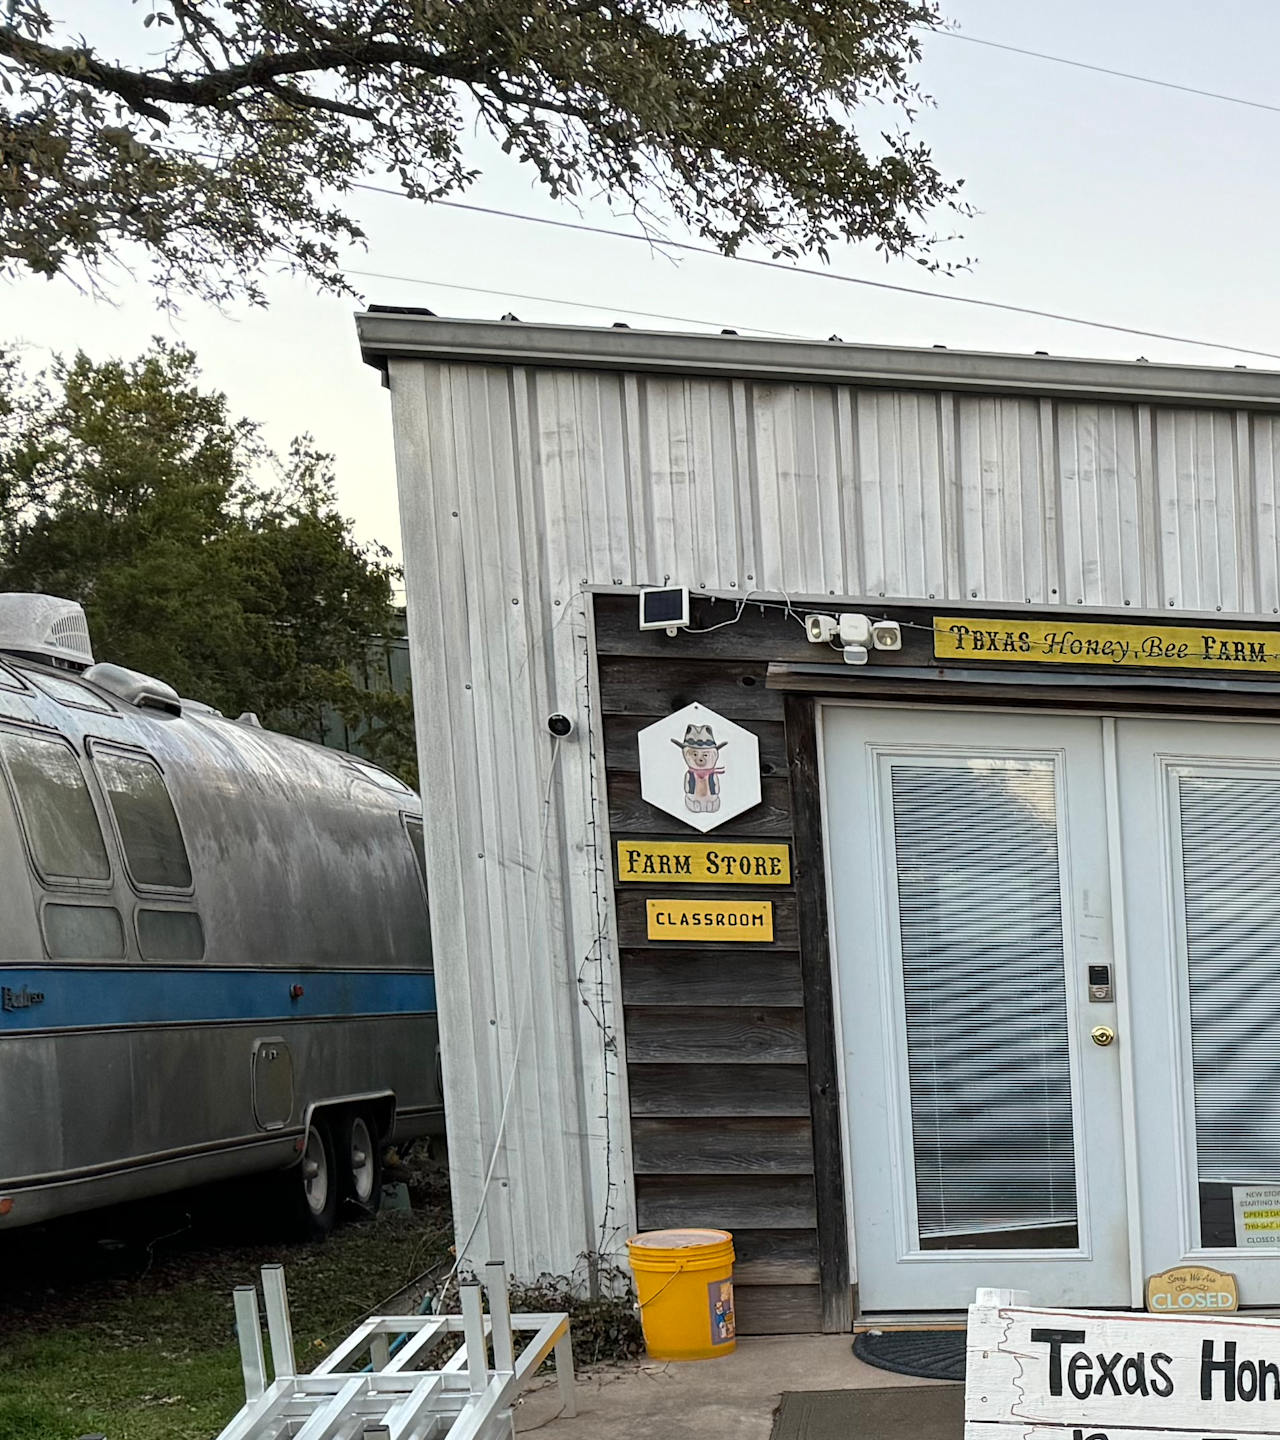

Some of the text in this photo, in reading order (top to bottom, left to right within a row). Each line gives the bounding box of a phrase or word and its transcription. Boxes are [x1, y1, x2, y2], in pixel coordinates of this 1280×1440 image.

[1042, 631, 1130, 663] Honey
[1141, 636, 1189, 660] Bee
[1201, 635, 1267, 664] FARM
[626, 850, 782, 876] FARM STORE
[656, 912, 764, 927] CLASSROOM
[1152, 1292, 1233, 1309] CLOSED
[1031, 1328, 1174, 1400] Texas
